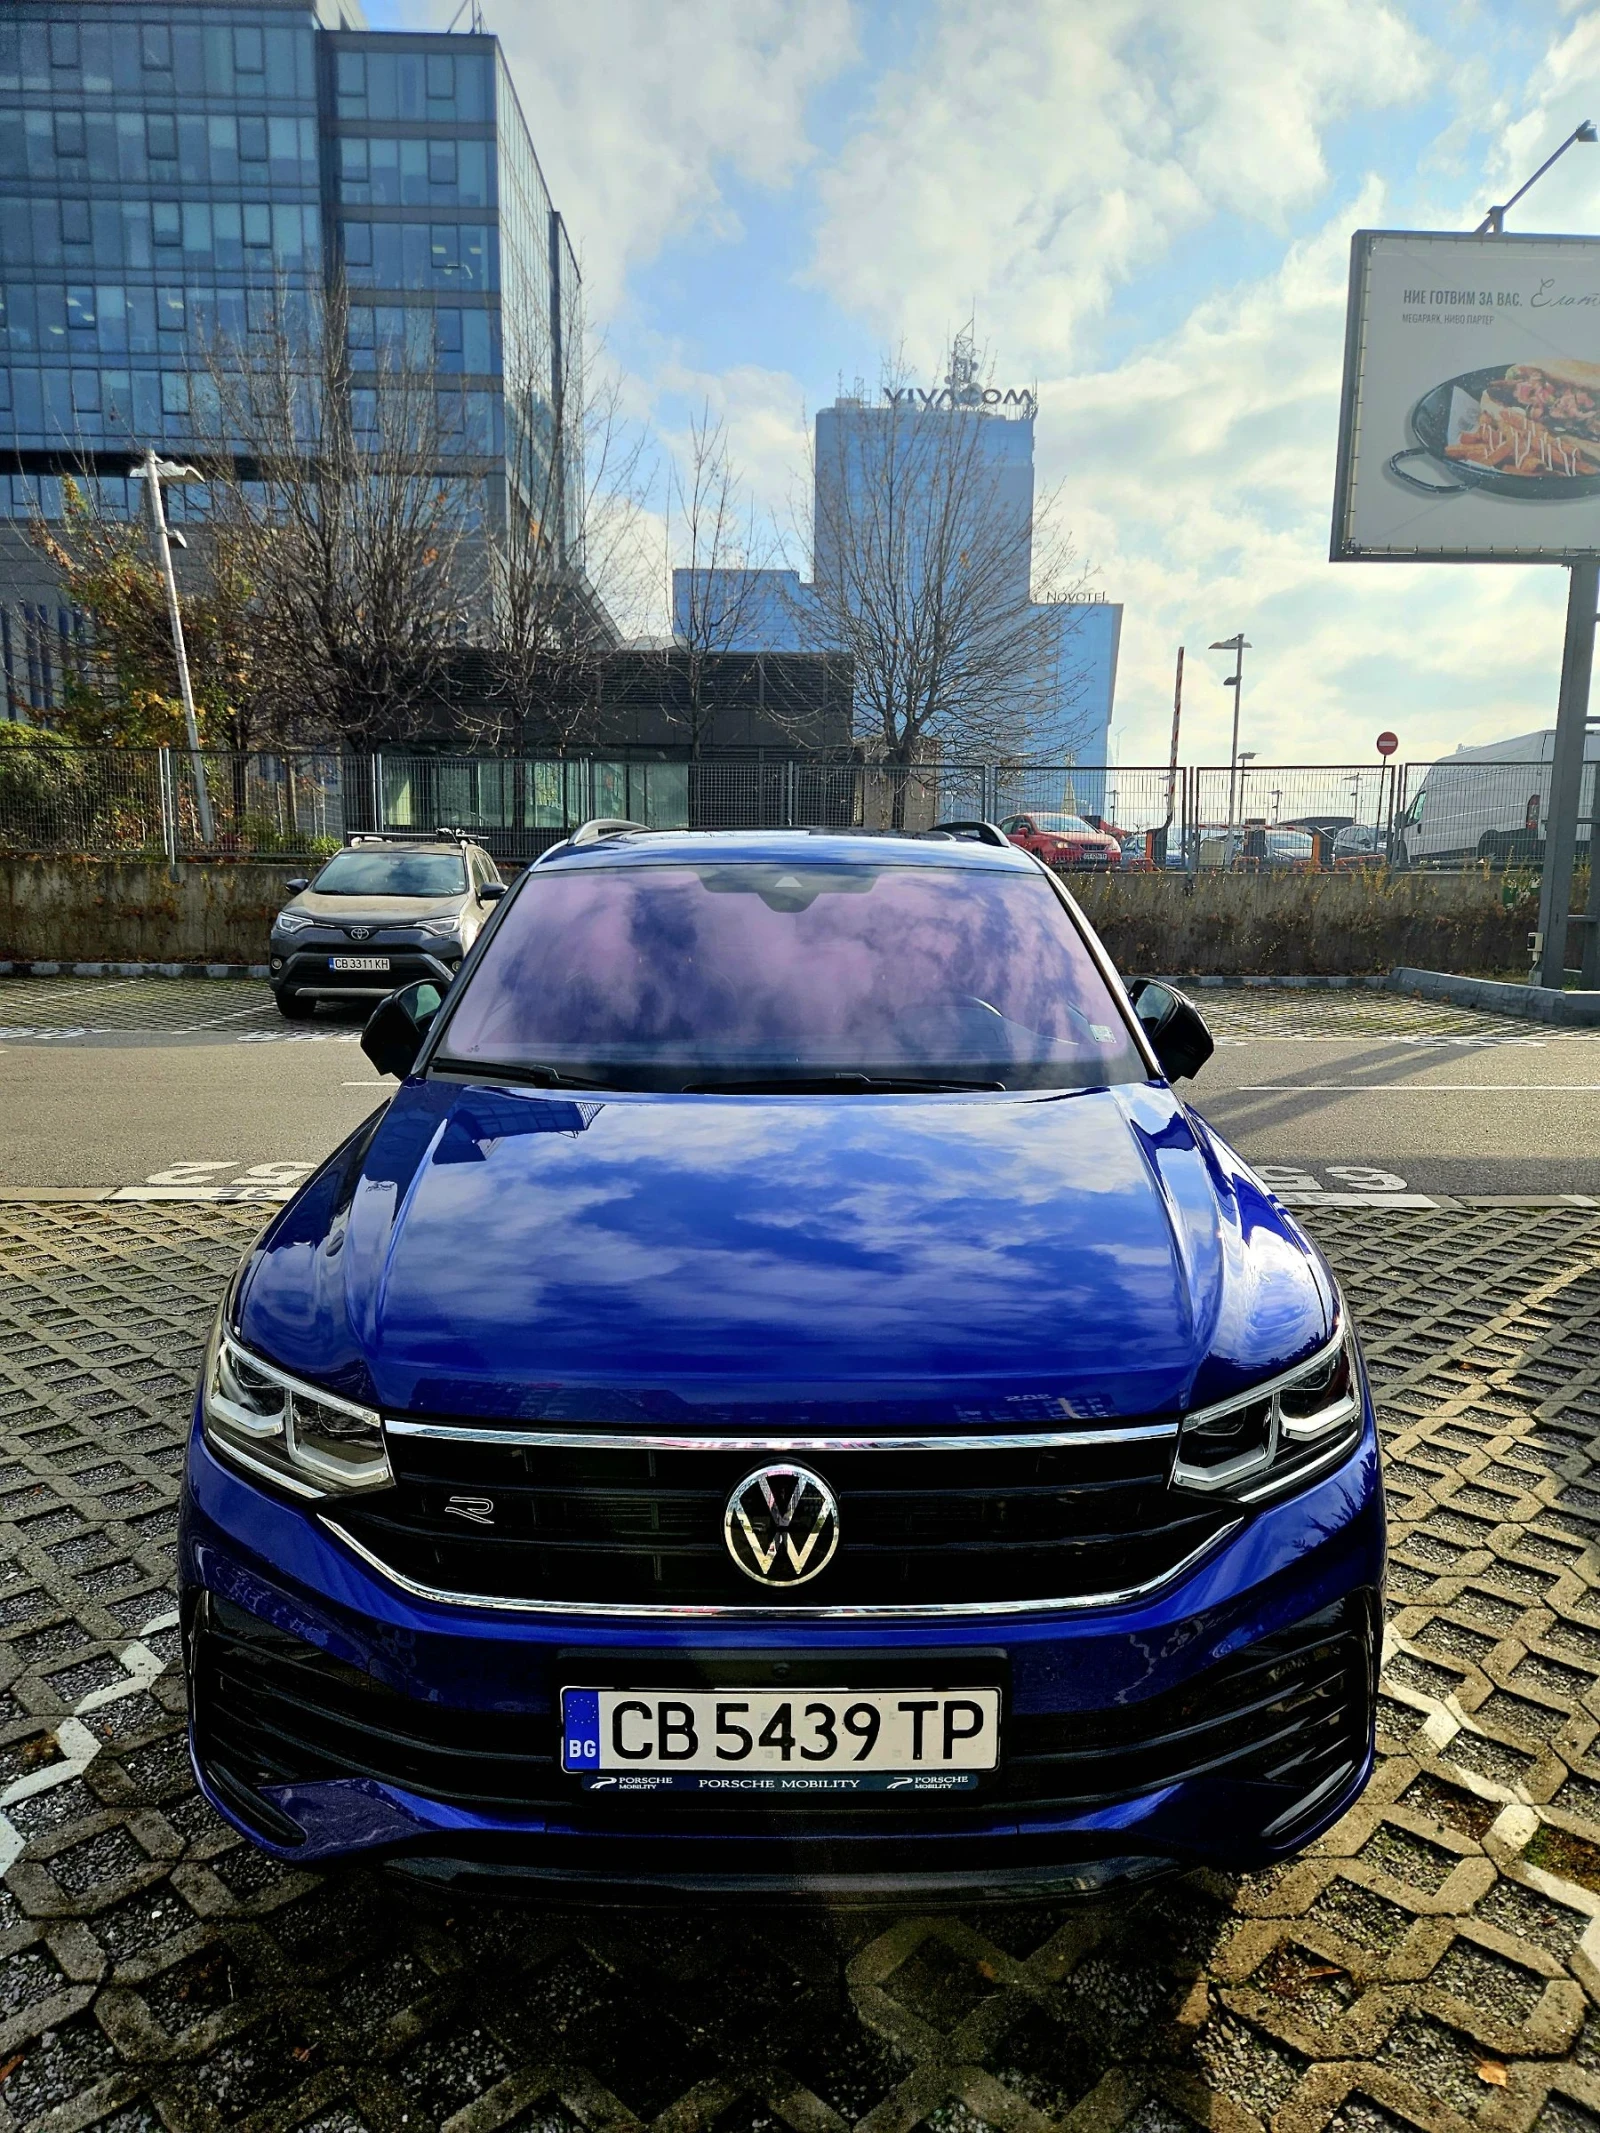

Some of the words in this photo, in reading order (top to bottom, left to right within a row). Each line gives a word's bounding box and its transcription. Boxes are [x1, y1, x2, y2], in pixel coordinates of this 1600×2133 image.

[1403, 290, 1426, 305] НИЕ
[1429, 290, 1476, 306] ГОТВИМ
[1479, 292, 1493, 306] ЗА
[1497, 292, 1523, 307] ВАС.
[1467, 314, 1495, 326] ПАРТЕР
[882, 387, 1034, 405] VIVAOM
[1046, 591, 1105, 604] NOVOTEL
[350, 959, 373, 968] 3311
[612, 1700, 699, 1760] CB
[716, 1702, 881, 1761] 5439
[897, 1700, 984, 1760] TP
[569, 1739, 597, 1757] BG
[699, 1779, 775, 1788] PORSCHE
[782, 1779, 860, 1788] MOBILITY
[915, 1776, 969, 1784] PORSCHE
